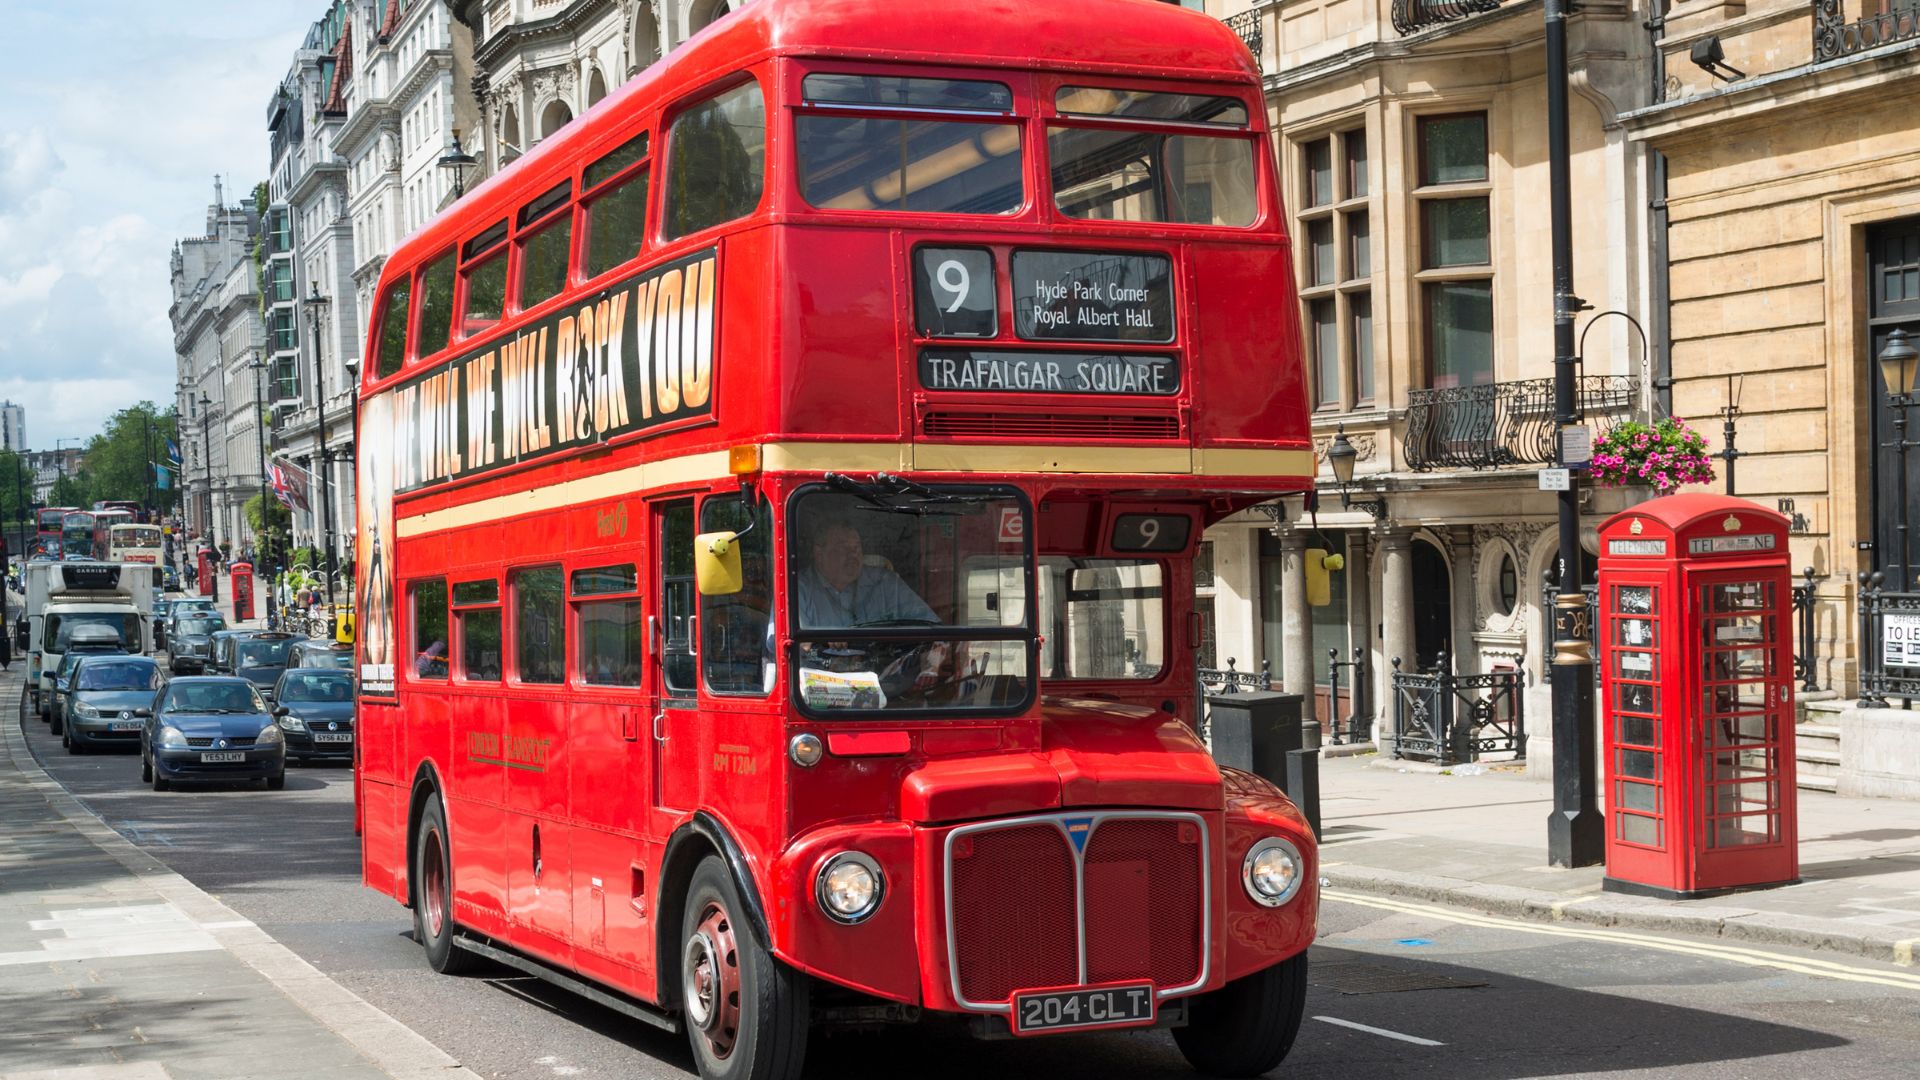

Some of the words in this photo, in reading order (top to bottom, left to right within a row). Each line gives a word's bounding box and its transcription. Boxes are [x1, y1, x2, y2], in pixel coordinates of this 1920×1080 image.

[936, 259, 970, 313] 9
[1035, 279, 1068, 305] Hyde
[1074, 281, 1102, 301] Park
[1109, 283, 1150, 302] Corner
[1034, 306, 1071, 329] Royal
[1077, 307, 1120, 327] Albert
[1126, 308, 1154, 328] Hall
[393, 385, 416, 491] WE
[420, 366, 462, 483] WILL
[466, 351, 495, 470] WE
[501, 325, 551, 460] WILL
[556, 290, 630, 444] ROCK
[637, 257, 715, 420] YOU
[928, 358, 1062, 390] TRAFALGAR
[1077, 362, 1167, 392] SQUARE
[1140, 518, 1160, 548] 9
[1611, 540, 1665, 554] TELEPHONE
[1888, 626, 1903, 640] TO
[204, 753, 226, 761] YE53
[226, 752, 242, 761] LHY
[466, 731, 499, 760] LONDON
[503, 735, 550, 771] TRANSPORT
[714, 753, 729, 772] RM
[1025, 995, 1080, 1026] 204
[1089, 989, 1145, 1020] CLT
